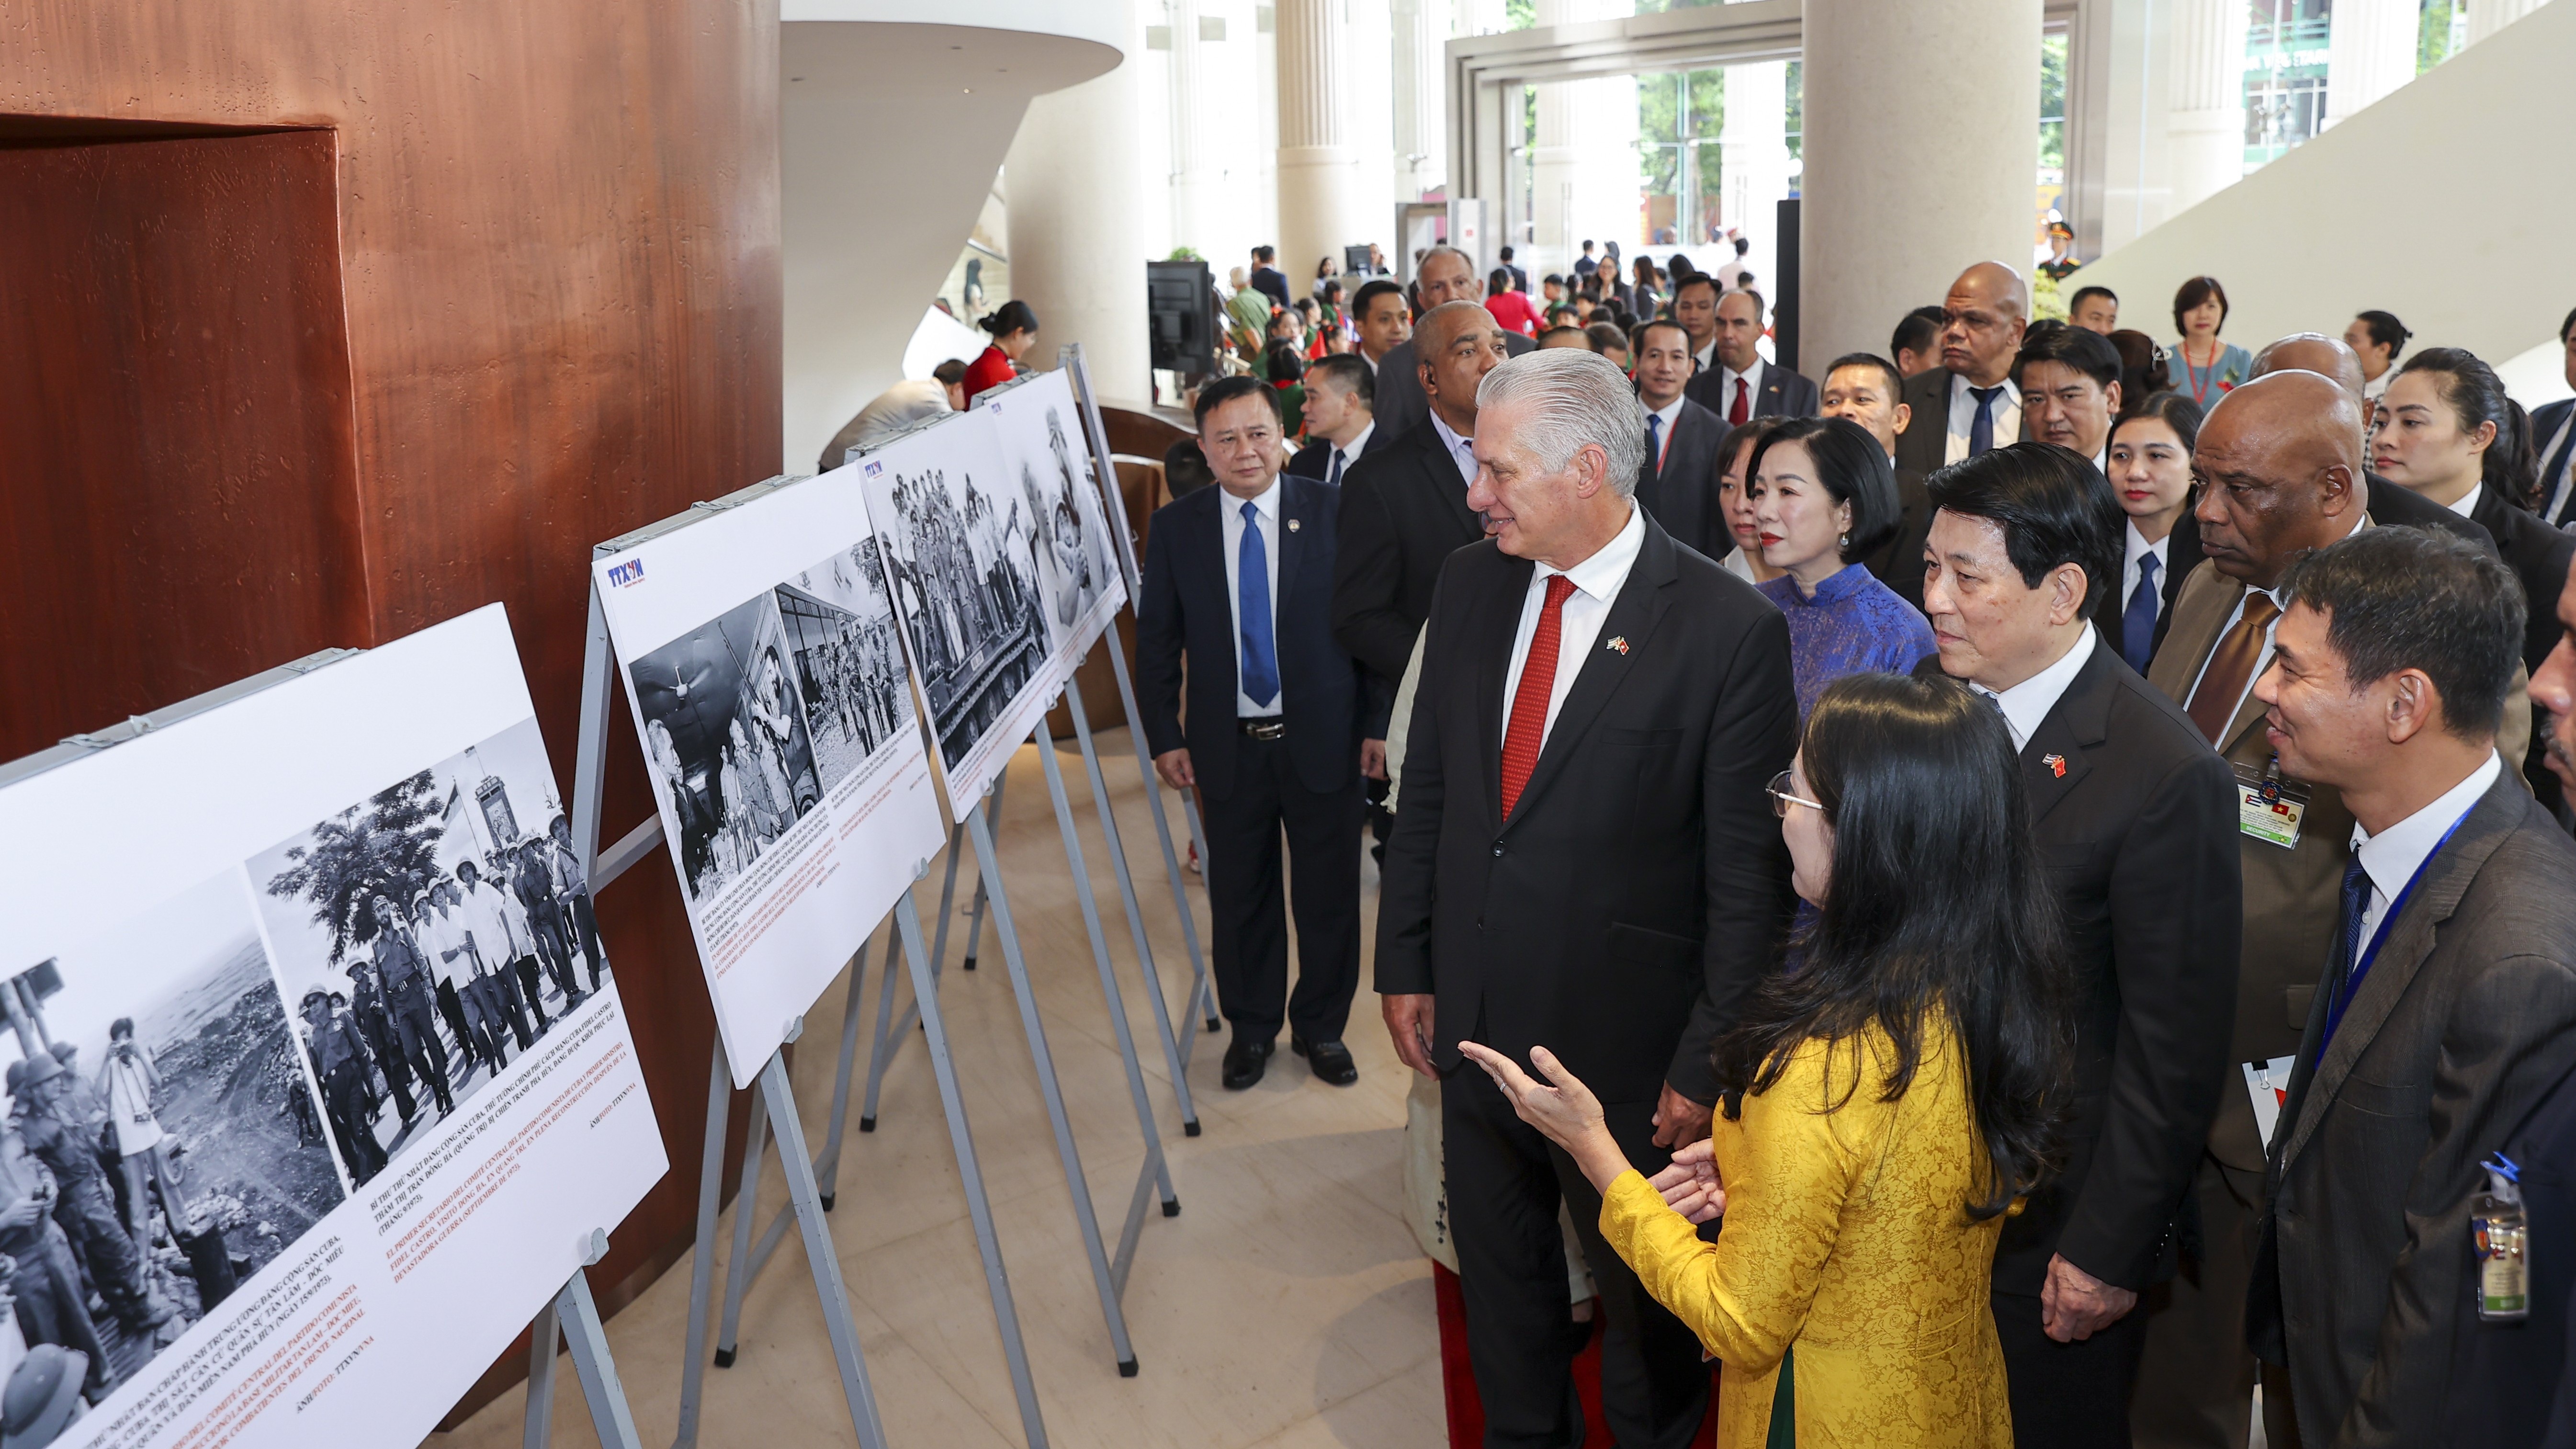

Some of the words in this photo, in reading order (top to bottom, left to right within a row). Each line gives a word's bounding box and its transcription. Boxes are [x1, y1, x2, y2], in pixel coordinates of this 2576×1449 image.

[2246, 826, 2271, 837] SECURITY
[370, 1198, 378, 1211] BÍ
[377, 1186, 392, 1204] THƯ
[392, 1174, 406, 1192] THỨ
[406, 1161, 423, 1180] NHẤT
[423, 1146, 441, 1166] ĐẢNG
[441, 1132, 458, 1151] CỘNG
[457, 1122, 469, 1136] SẢN
[468, 1111, 486, 1127] CUBA,
[484, 1098, 496, 1112] THỦ
[514, 1069, 531, 1087] CHÍNH
[531, 1059, 541, 1074] PHỦ
[541, 1049, 555, 1064] CÁCH
[554, 1037, 570, 1053] MẠNG
[569, 1027, 582, 1041] CUBA
[581, 1016, 595, 1030] FIDEL
[594, 1001, 611, 1019] CASTRO
[373, 1201, 394, 1223] THĂM
[394, 1191, 407, 1205] THỊ
[407, 1176, 424, 1194] TRẤN
[425, 1160, 443, 1179] ĐÔNG
[443, 1150, 453, 1163] HÀ
[453, 1132, 475, 1155] (QUẢNG
[475, 1121, 488, 1135] TRỊ)
[487, 1114, 495, 1124] BỊ
[495, 1099, 512, 1118] CHIẾN
[511, 1084, 530, 1103] TRANH
[530, 1073, 542, 1087] PHÁ
[553, 1052, 567, 1067] ĐANG
[567, 1040, 581, 1055] ĐƯỢC
[581, 1029, 594, 1043] KHÔI
[593, 1018, 606, 1032] PHỤC
[606, 1010, 615, 1022] LẠI
[385, 1248, 396, 1259] EL
[394, 1226, 419, 1252] PRIMER
[418, 1195, 453, 1231] SECRETARIO
[452, 1186, 465, 1199] DEL
[463, 1165, 486, 1189] COMITÉ
[485, 1145, 509, 1169] CENTRAL
[508, 1136, 519, 1149] DEL
[518, 1117, 539, 1140] PARTIDO
[538, 1094, 565, 1121] COMUNISTA
[564, 1087, 572, 1098] DE
[570, 1075, 584, 1091] CUBA
[586, 1059, 603, 1078] PRIMER
[601, 1041, 623, 1063] MINISTRO,
[390, 1251, 410, 1272] FIDEL
[410, 1226, 437, 1253] CASTRO,
[436, 1204, 458, 1227] VISITÓ
[458, 1189, 475, 1209] DONG
[475, 1181, 486, 1192] HA,
[486, 1171, 495, 1182] EN
[495, 1153, 515, 1174] QUANG
[515, 1143, 527, 1155] TRI,
[526, 1135, 534, 1145] EN
[534, 1120, 552, 1138] PLENA
[551, 1080, 593, 1122] RECONSTRUCCIÓN
[593, 1063, 613, 1084] DESPUÉS
[612, 1056, 620, 1066] DE
[619, 1051, 627, 1060] LA
[378, 1210, 403, 1236] (THÁNG
[402, 1194, 423, 1213] 9/1973).
[394, 1239, 439, 1284] DEVASTADORA
[438, 1217, 463, 1242] GUERRA
[463, 1181, 499, 1221] (SEPTIEMBRE
[498, 1174, 507, 1186] DE
[507, 1163, 521, 1178] 1973).
[124, 1415, 151, 1441] CUBA
[151, 1397, 169, 1416] THỊ
[170, 1380, 188, 1400] SÁT
[226, 1326, 250, 1351] QUÂN
[252, 1313, 263, 1329] SỰ
[265, 1299, 282, 1317] TÂN
[282, 1282, 301, 1302] LÂM
[307, 1263, 323, 1281] DỐC
[325, 1245, 343, 1266] MIẾU
[136, 1391, 158, 1411] BAN
[157, 1368, 181, 1393] CHẤP
[181, 1346, 208, 1373] HÀNH
[206, 1321, 237, 1350] TRUNG
[236, 1301, 261, 1325] ƯƠNG
[260, 1282, 283, 1305] ĐẢNG
[282, 1263, 305, 1286] CỘNG
[304, 1251, 319, 1268] SẢN
[318, 1235, 341, 1255] CUBA,
[162, 1407, 178, 1423] VÀ
[178, 1391, 197, 1413] DÂN
[197, 1370, 221, 1395] MIỀN
[220, 1352, 241, 1374] NAM
[240, 1336, 259, 1357] PHÁ
[275, 1300, 299, 1327] (NGÀY
[299, 1274, 332, 1305] 15/9/1973).
[204, 1389, 237, 1425] COMITÉ
[237, 1359, 274, 1394] CENTRAL
[272, 1342, 291, 1363] DEL
[287, 1317, 318, 1349] PARTIDO
[317, 1284, 357, 1321] COMUNISTA
[229, 1380, 287, 1438] COMBATIENTES
[287, 1367, 304, 1383] DEL
[303, 1339, 329, 1369] FRENTE
[330, 1308, 365, 1343] NACIONAL
[230, 1405, 244, 1419] LA
[241, 1386, 262, 1409] BASE
[261, 1358, 294, 1389] MILITAR
[292, 1346, 307, 1361] TAN
[306, 1329, 323, 1349] LAM
[327, 1312, 341, 1330] DOC
[341, 1296, 361, 1316] MIEU,
[296, 1373, 335, 1414] ẢNH/FOTO:
[335, 1336, 374, 1375] TTXVN/VNA
